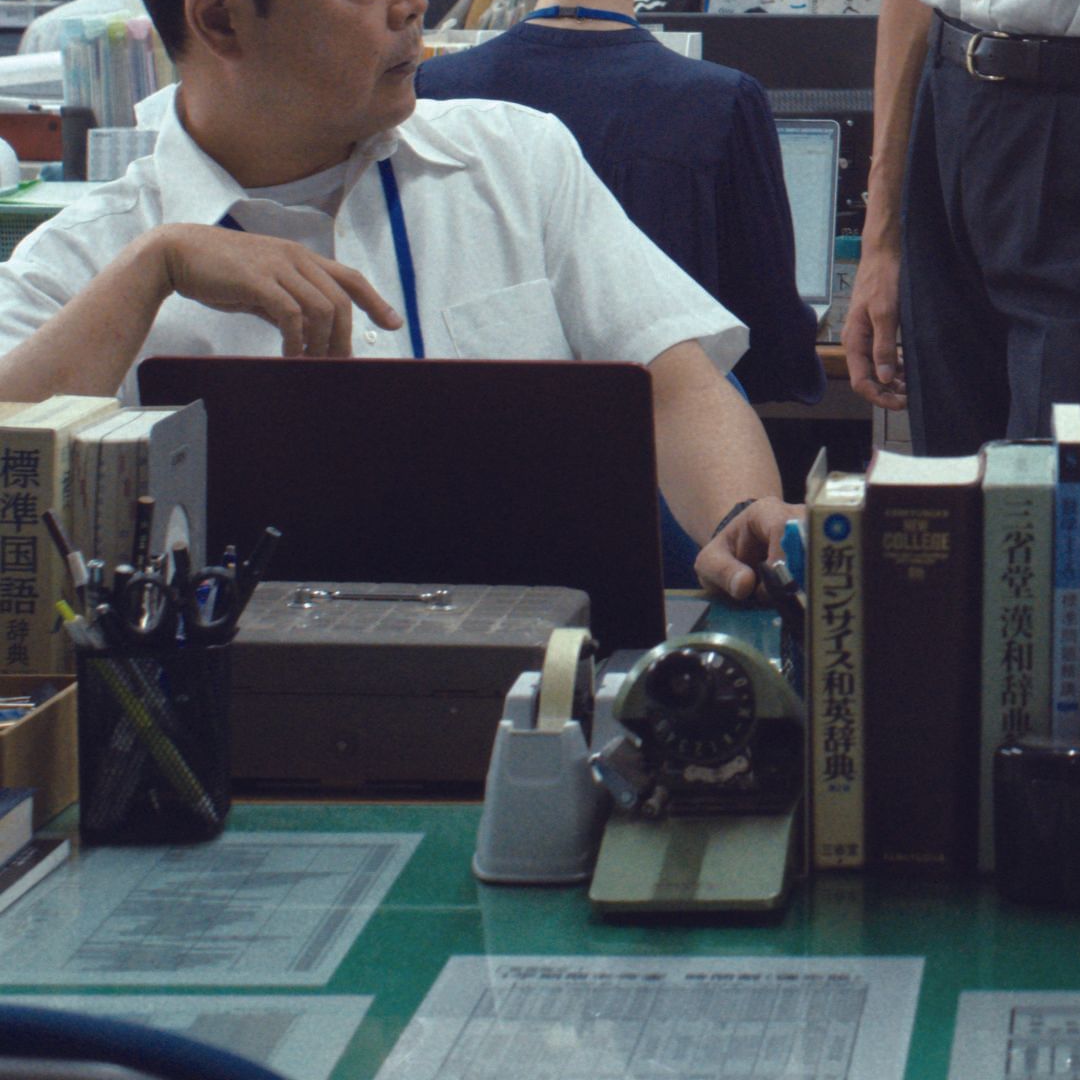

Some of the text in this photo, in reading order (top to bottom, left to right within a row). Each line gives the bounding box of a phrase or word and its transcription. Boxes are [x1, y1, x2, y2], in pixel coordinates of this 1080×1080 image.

[0, 449, 39, 666] 標準国語辞典
[883, 532, 949, 551] COLLEGE
[820, 545, 857, 782] 新コンサイス和英辞典
